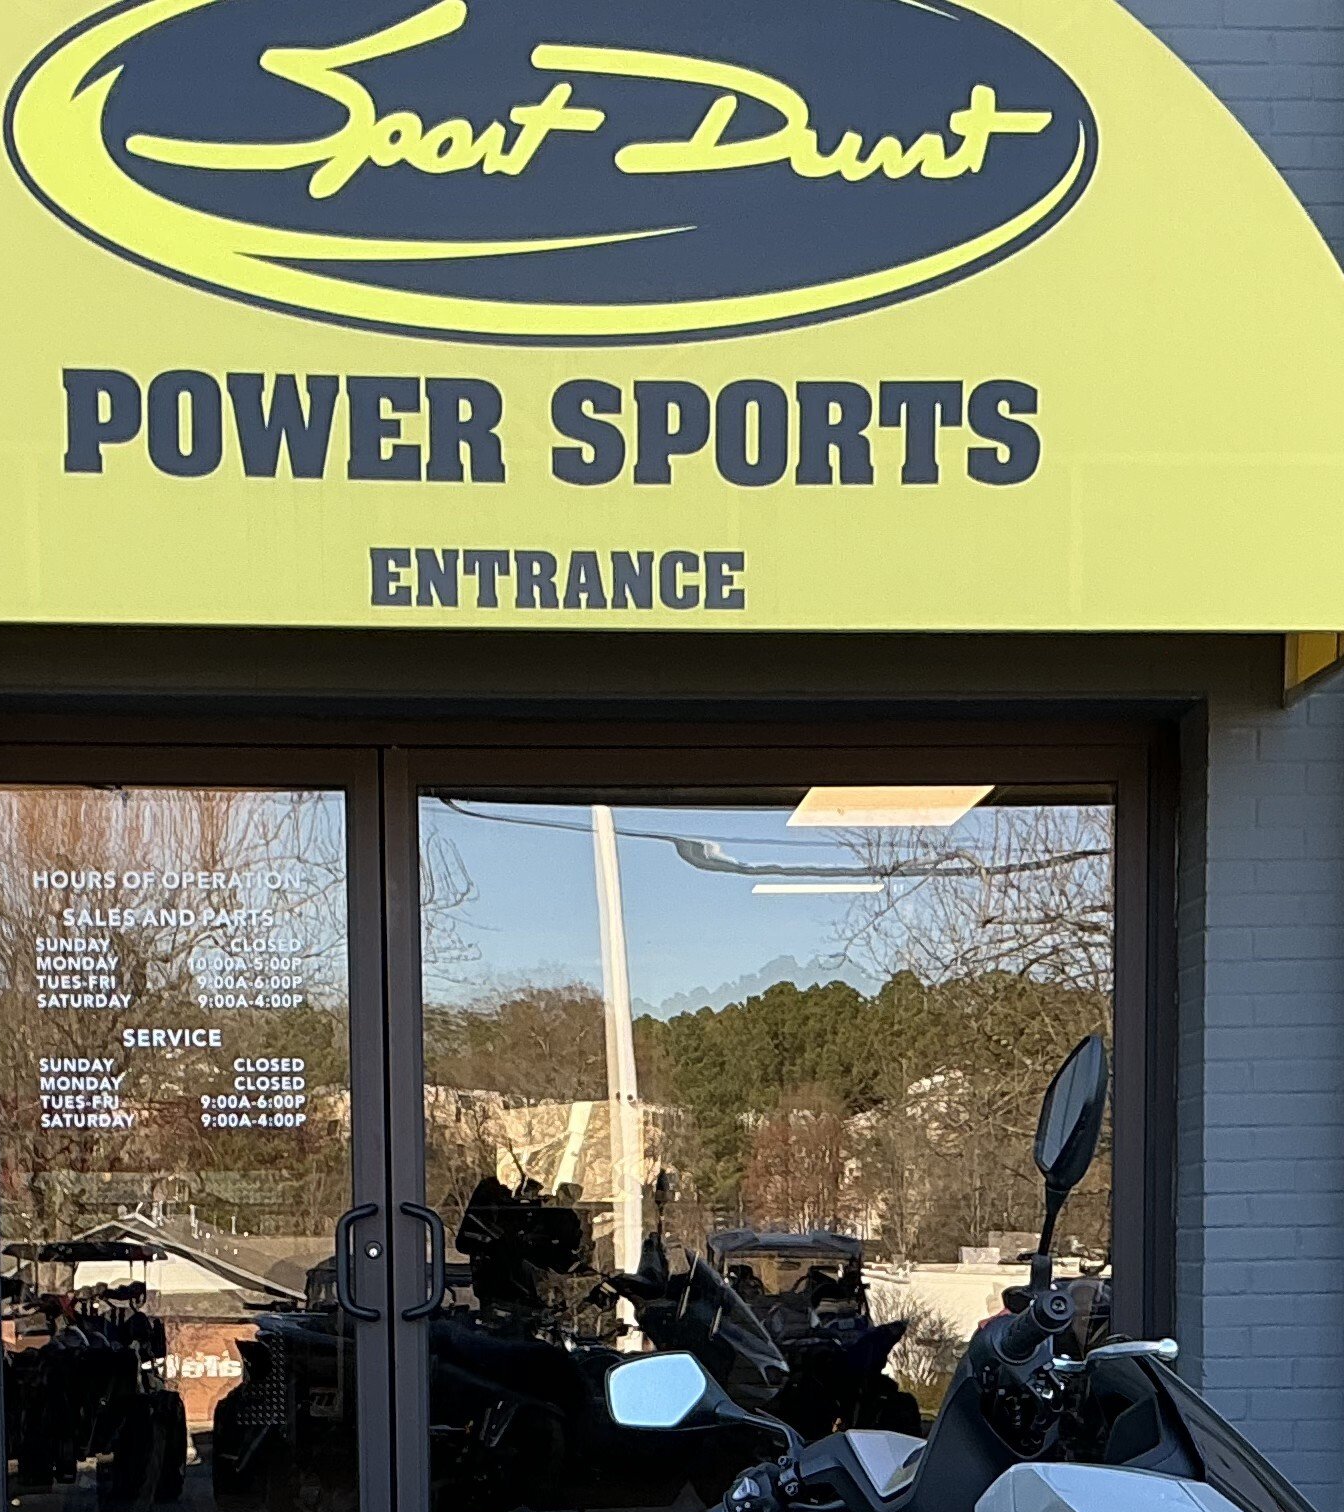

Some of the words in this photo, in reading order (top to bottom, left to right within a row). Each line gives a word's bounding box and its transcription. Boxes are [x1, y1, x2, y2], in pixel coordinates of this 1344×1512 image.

[125, 0, 605, 199] Sport
[63, 367, 507, 484] POWER
[550, 379, 1041, 487] SPORTS
[370, 547, 747, 612] ENTRANCE
[32, 870, 117, 890] HOURS
[122, 871, 156, 890] OF
[161, 871, 302, 890] OPERATION
[62, 908, 135, 927] SALES
[142, 908, 196, 927] AND
[202, 909, 274, 927] PARTS
[35, 937, 111, 952] SUNDAY
[230, 938, 302, 953] CLOSED
[36, 957, 119, 971] MONDAY
[37, 975, 116, 990] TUES-FRI
[197, 975, 304, 990] 9:00A-6:00P
[37, 993, 132, 1009] SATURDAY
[197, 994, 304, 1009] 9:00A-4:00P
[122, 1028, 223, 1048] SERVICE
[39, 1058, 115, 1073] SUNDAY
[233, 1058, 306, 1073] CLOSED
[40, 1076, 124, 1092] MONDAY
[233, 1076, 306, 1092] CLOSED
[40, 1094, 120, 1110] TUES-FRI
[200, 1094, 306, 1110] 9:00A-6:00P
[41, 1113, 135, 1128] SATURDAY
[201, 1113, 307, 1128] 9:00A-4:00P
